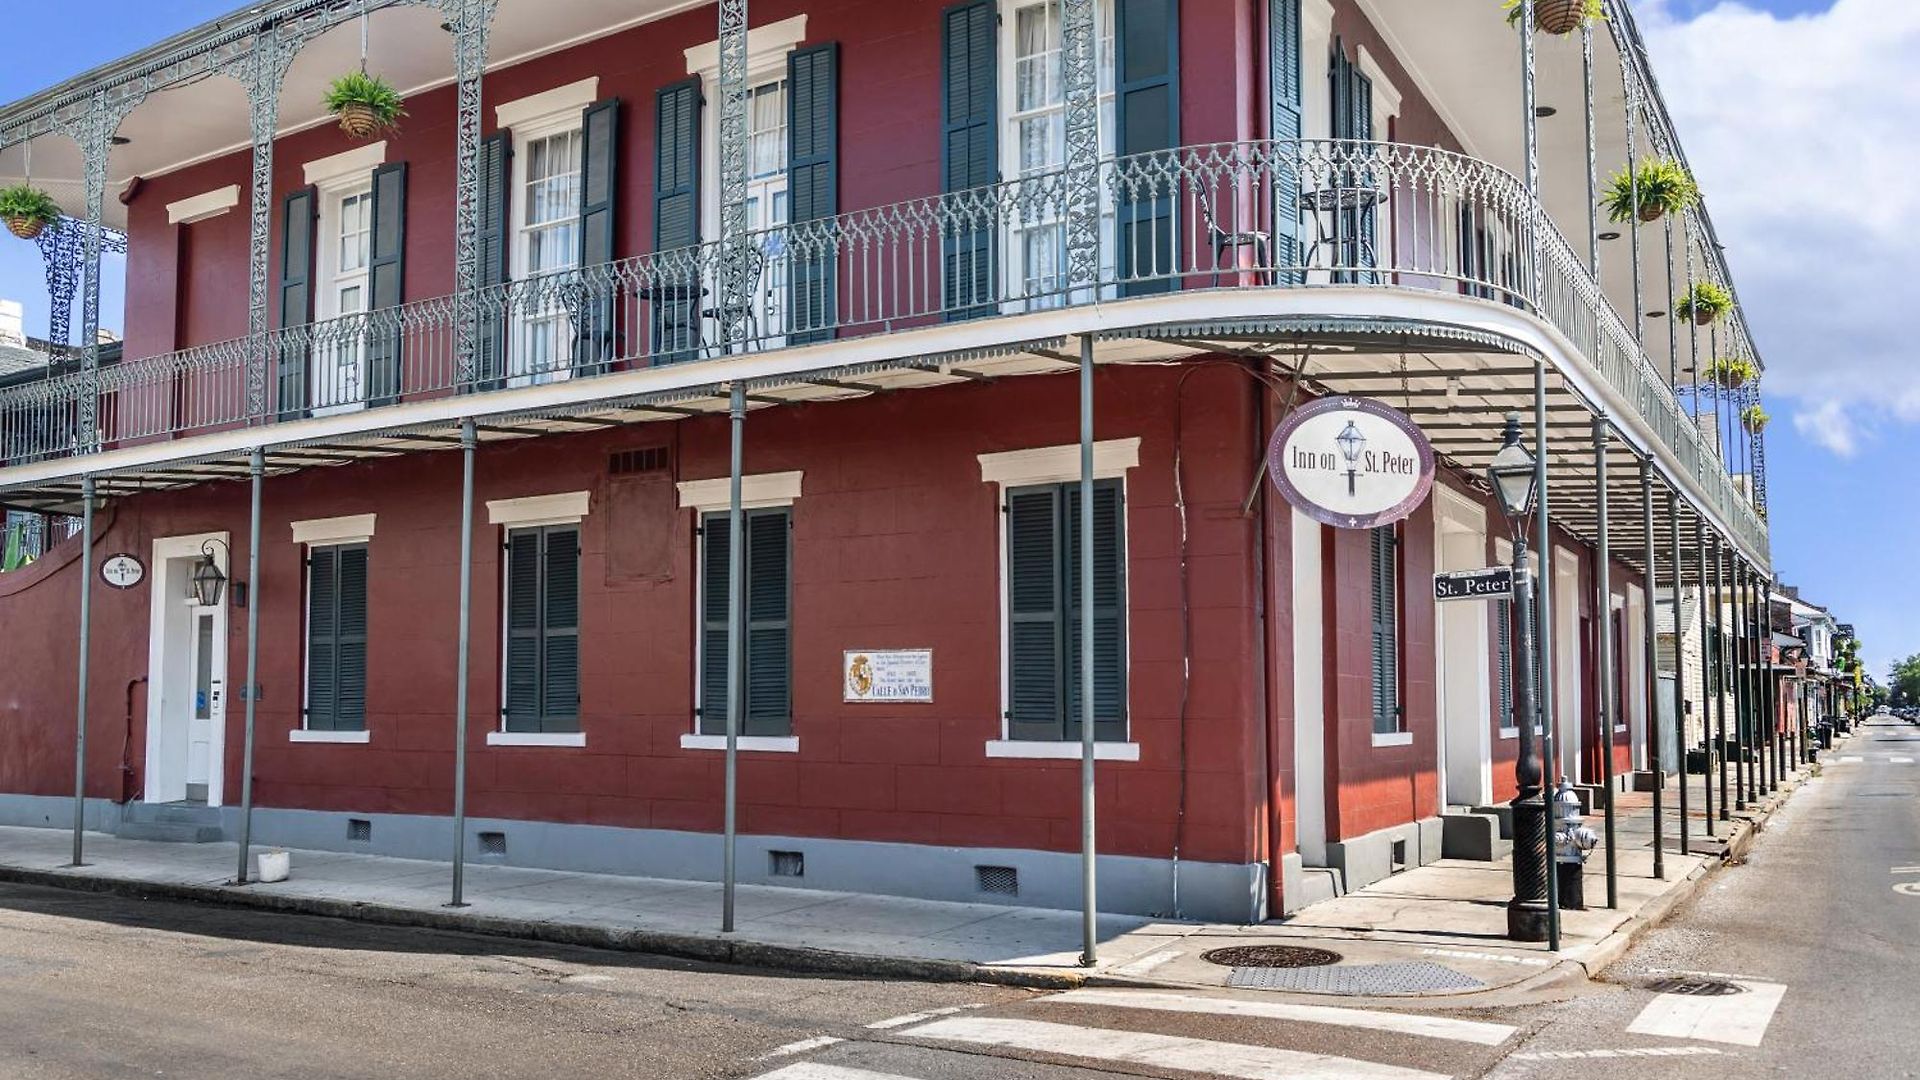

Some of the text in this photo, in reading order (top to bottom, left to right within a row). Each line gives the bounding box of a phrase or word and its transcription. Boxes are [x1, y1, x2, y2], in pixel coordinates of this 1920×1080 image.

[1293, 446, 1413, 475] Inn on St. Peter
[1437, 579, 1509, 596] St. Peter
